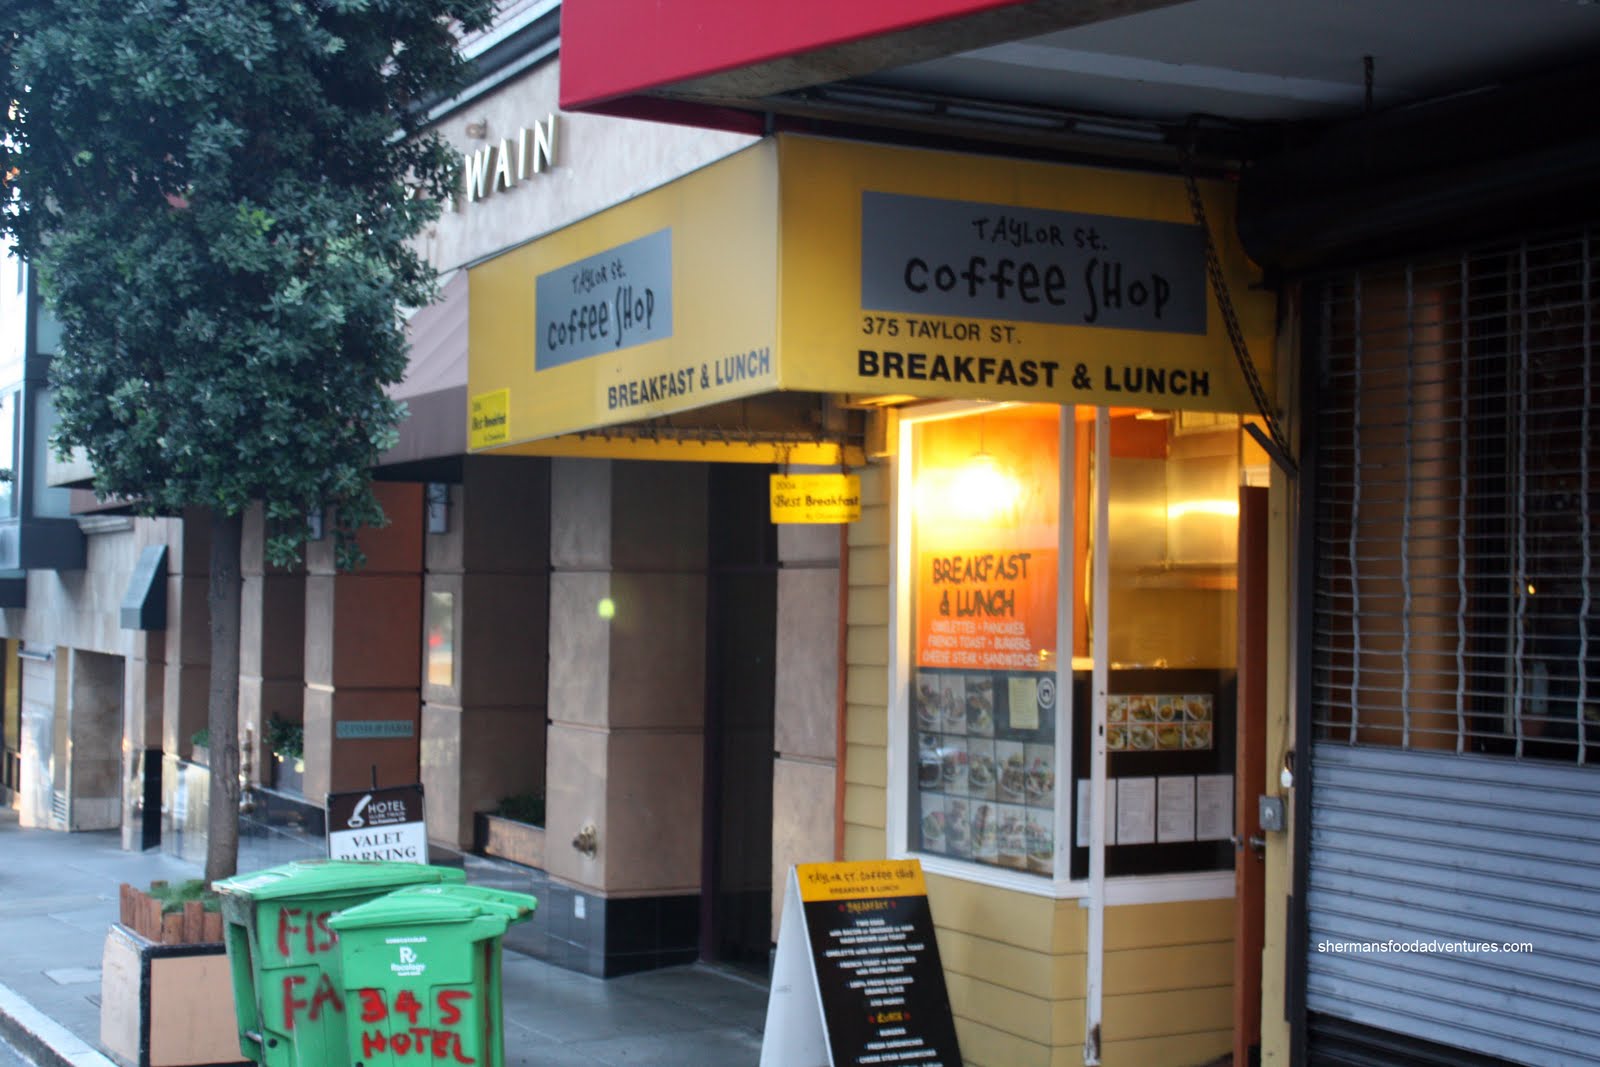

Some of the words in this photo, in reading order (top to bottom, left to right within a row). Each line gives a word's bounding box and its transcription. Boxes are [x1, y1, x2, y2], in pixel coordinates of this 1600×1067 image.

[971, 216, 1064, 249] TAYLOR
[572, 265, 608, 295] TAYLOR
[862, 316, 900, 337] 375
[906, 319, 981, 343] TAYLOR
[990, 323, 1021, 345] ST.
[608, 367, 695, 411] BREAKFAST
[700, 366, 710, 389] &
[715, 347, 770, 386] LUNCH
[858, 349, 1059, 389] BREAKFAST
[1072, 362, 1092, 391] &
[1104, 365, 1210, 397] LUNCH
[805, 494, 859, 507] Breakfast
[932, 553, 1031, 584] BREAKFAST
[956, 589, 1015, 618] LUNCH
[367, 800, 407, 814] HOTEL
[352, 831, 404, 848] VALET
[277, 906, 339, 957] FIS
[282, 972, 345, 1031] FA
[363, 1027, 475, 1065] HOTEL
